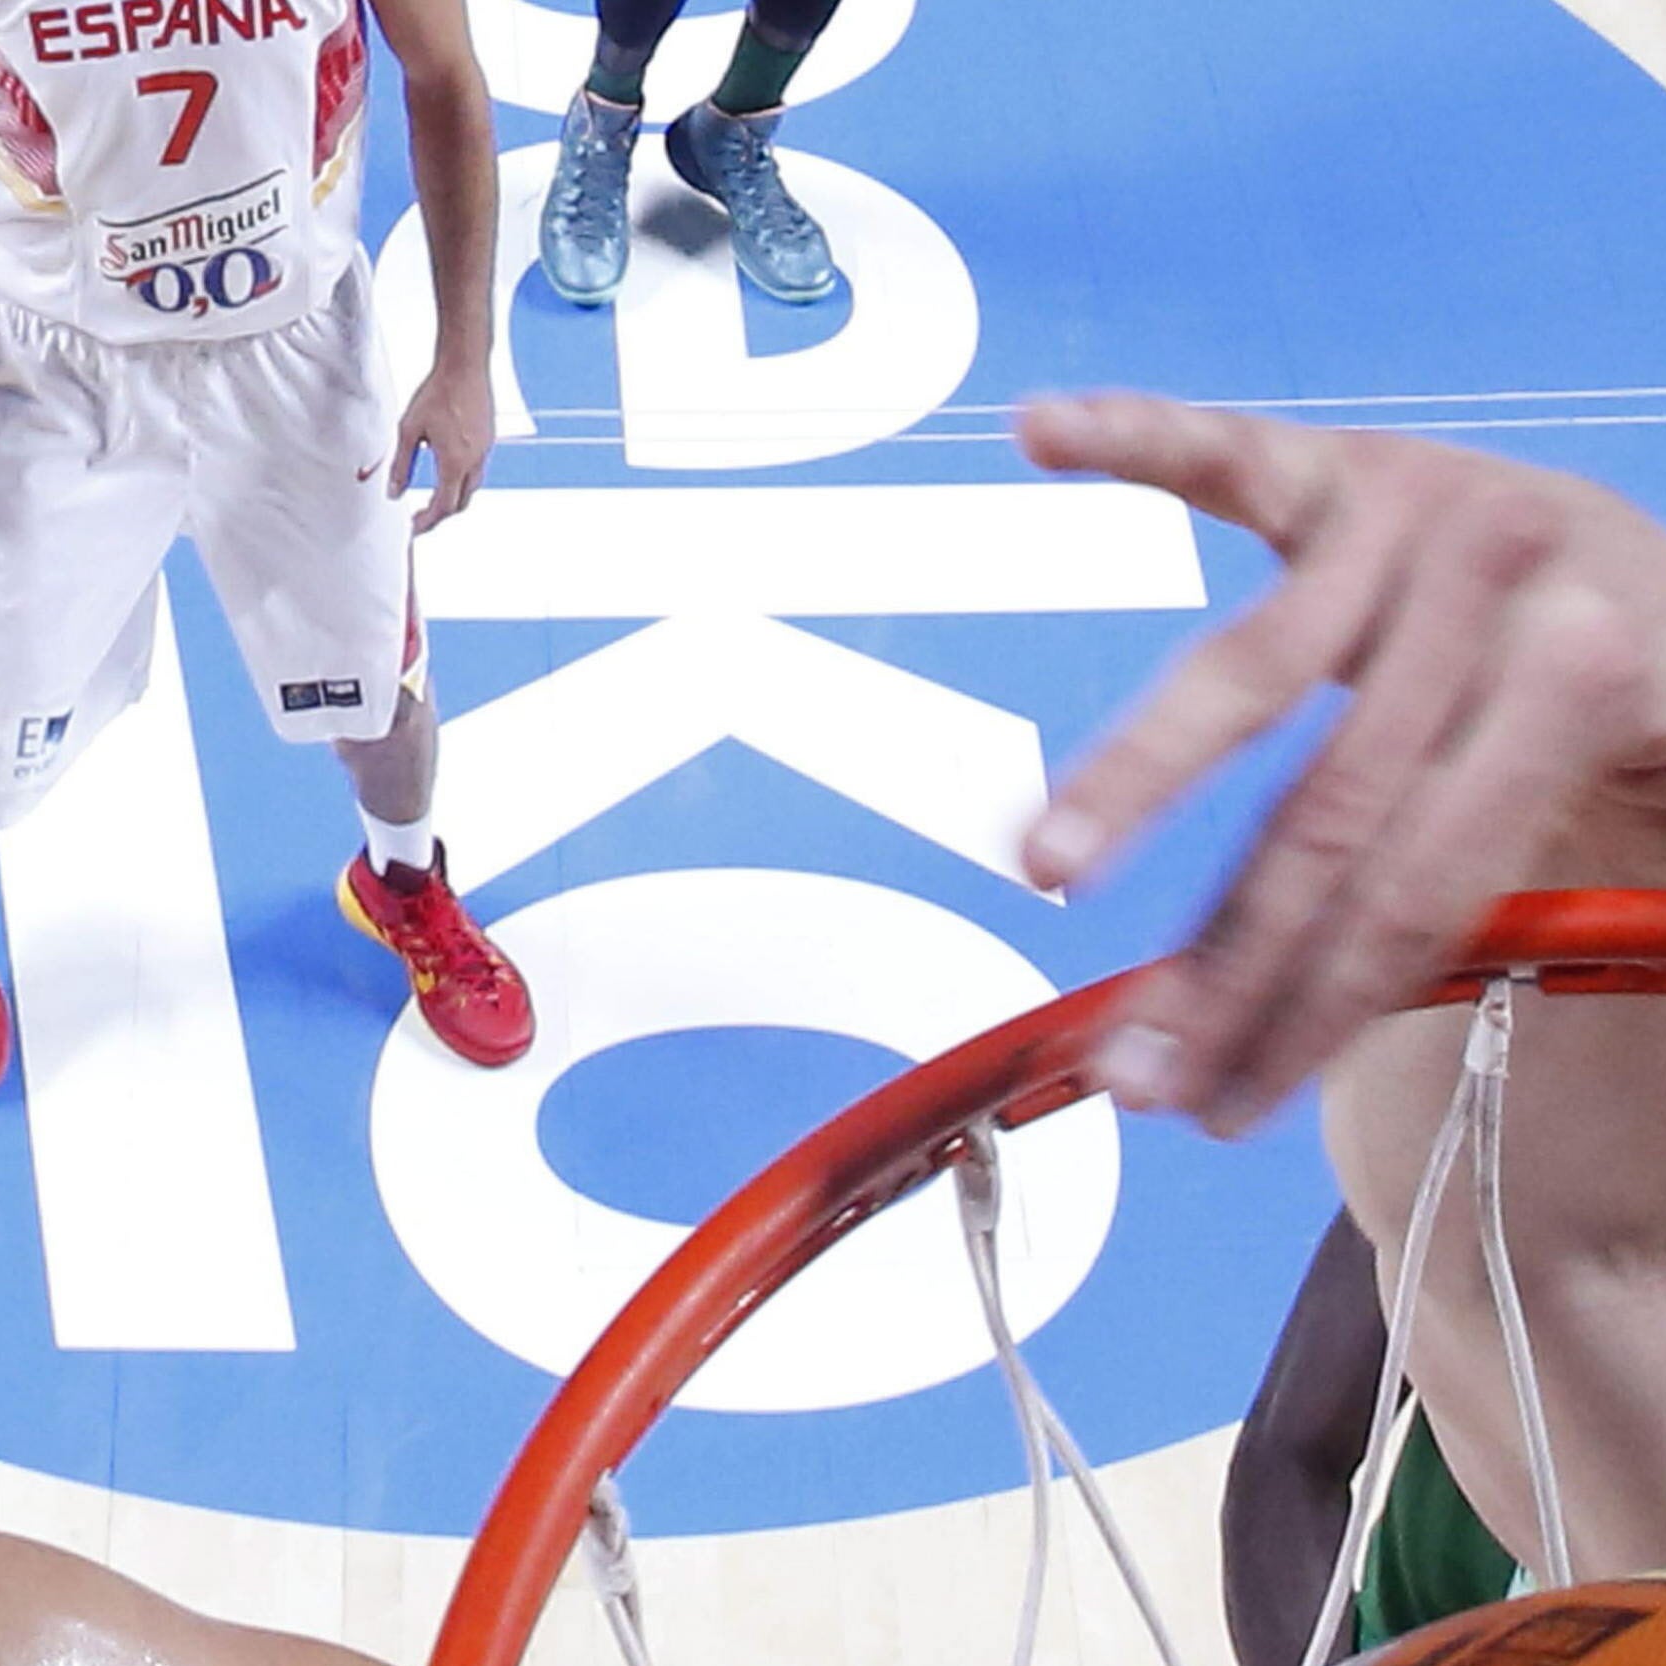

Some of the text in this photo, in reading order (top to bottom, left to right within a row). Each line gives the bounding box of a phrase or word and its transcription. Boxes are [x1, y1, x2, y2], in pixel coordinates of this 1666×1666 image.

[137, 70, 218, 166] 7
[100, 188, 281, 270] San Miguel
[137, 247, 273, 318] 0,0
